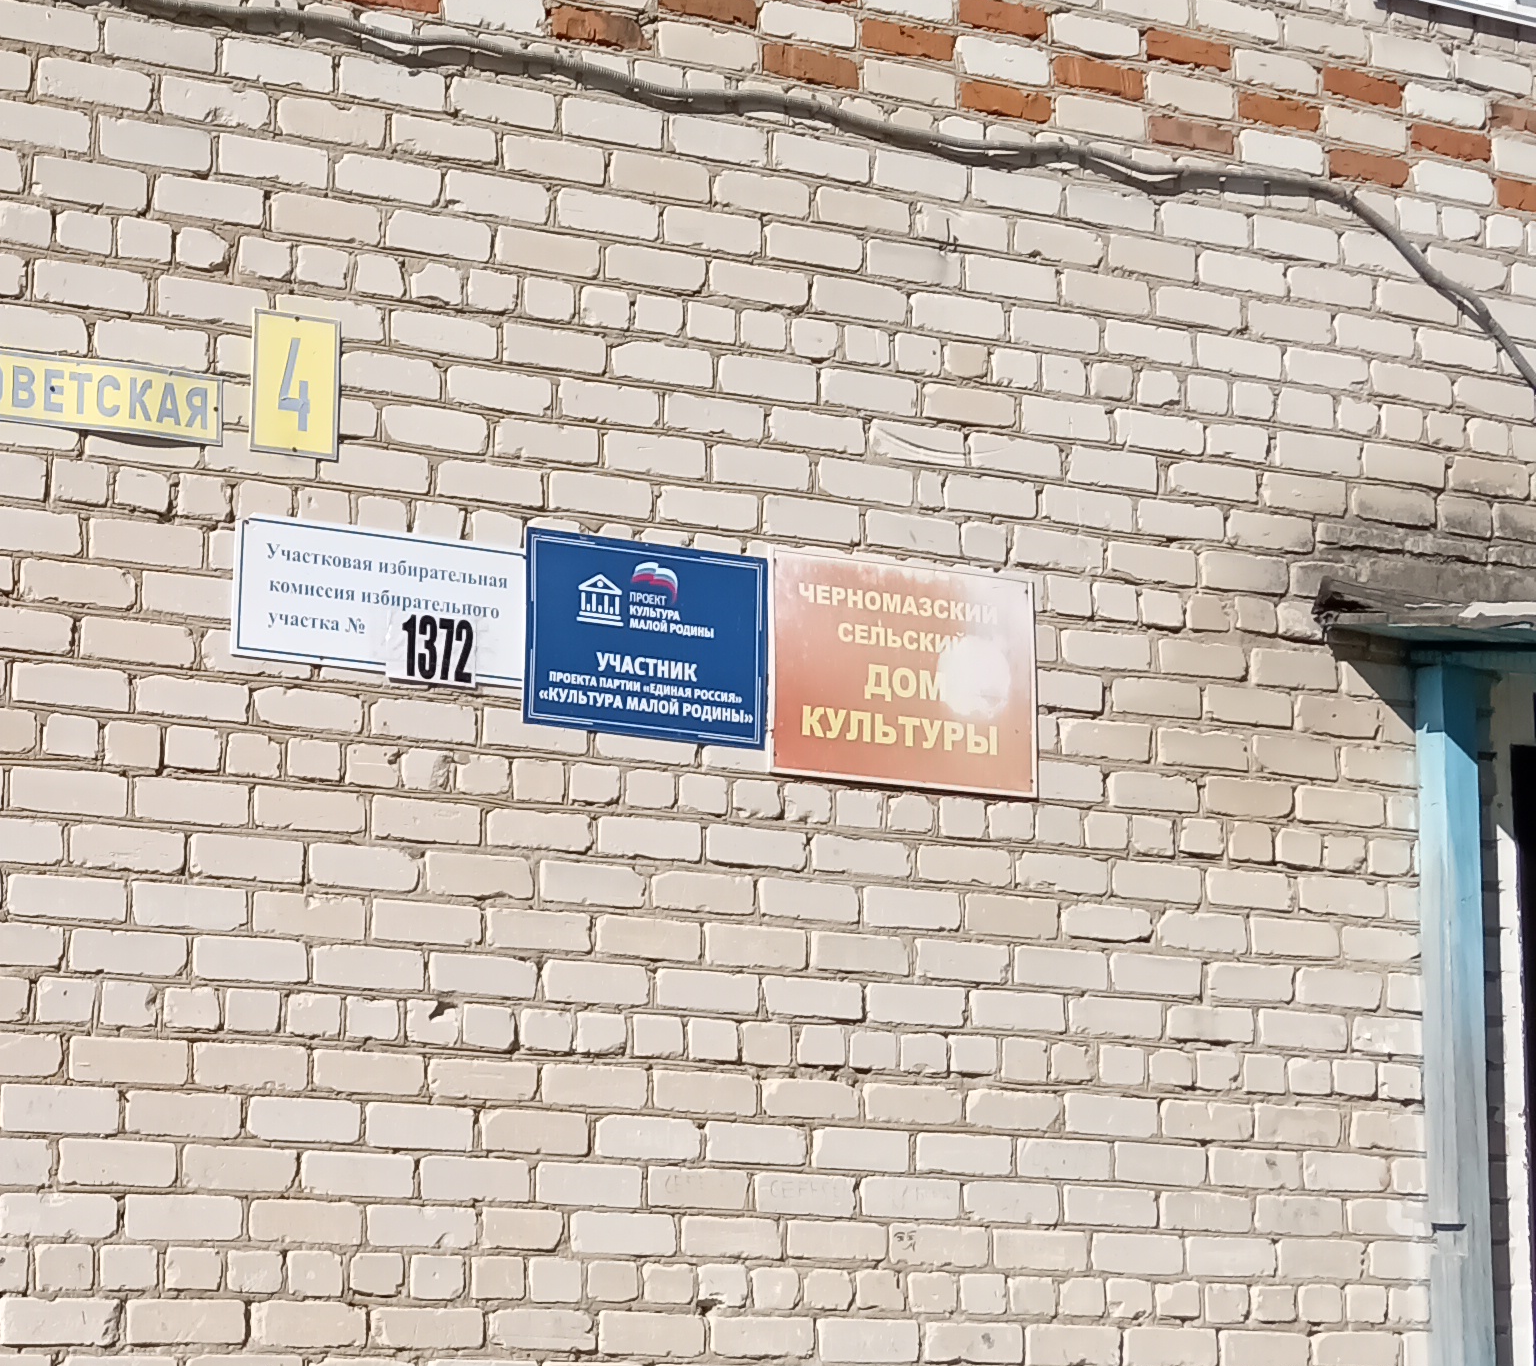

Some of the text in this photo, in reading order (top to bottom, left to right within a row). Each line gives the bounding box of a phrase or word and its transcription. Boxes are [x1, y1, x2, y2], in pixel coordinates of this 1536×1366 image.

[277, 337, 311, 432] 4
[266, 542, 509, 590] Участковая избирательная
[269, 578, 500, 620] комиссия избирательного
[629, 591, 668, 606] ПРОЕКТ
[629, 605, 681, 621] КУЛЬТУРА
[798, 582, 998, 625] ЧЕРНОМАЗСКИЙ
[267, 611, 474, 684] участка № 1372
[629, 618, 715, 639] МАЛОЙ РОДИНЫ
[596, 651, 698, 682] УЧАСТНИК
[864, 663, 947, 702] ДОМ
[538, 687, 754, 724] «КУЛЬТУРА МАЛОЙ РОДИНЫ»
[549, 670, 743, 704] ПРОЕКТА ПАРТИИ «ЕДИНАЯ РОССИЯ»
[801, 705, 998, 756] КУЛЬТУРЫ
